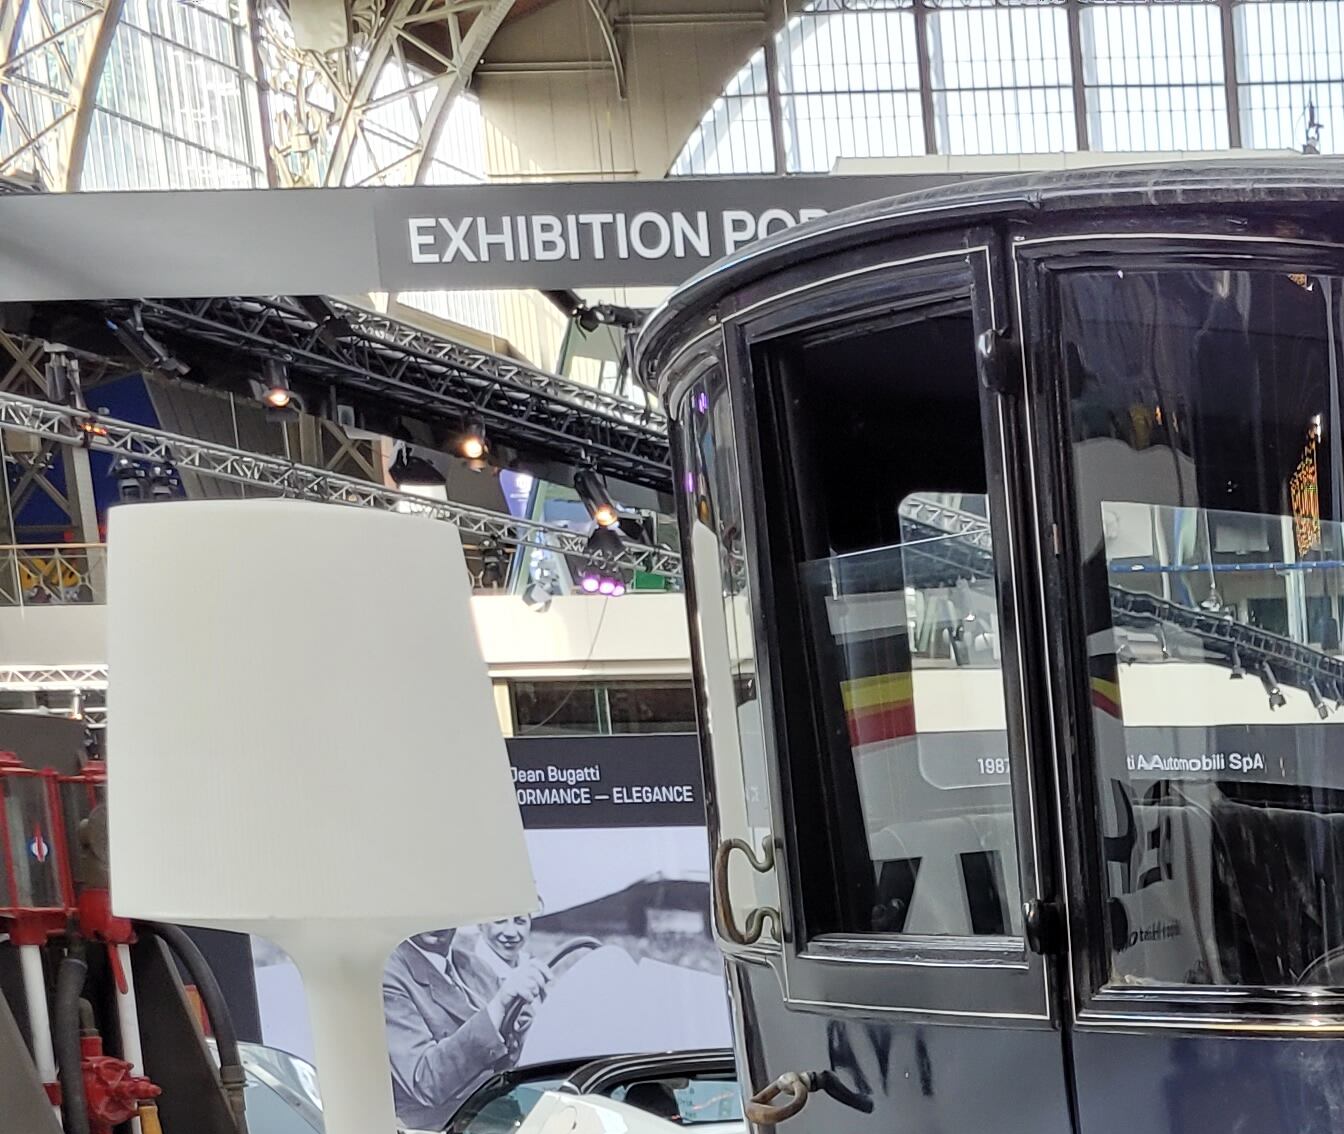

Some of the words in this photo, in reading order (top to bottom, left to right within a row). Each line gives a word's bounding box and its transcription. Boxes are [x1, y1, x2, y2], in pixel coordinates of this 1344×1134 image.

[408, 211, 710, 263] EXHIBITION
[1229, 752, 1264, 773] SpA
[511, 766, 545, 783] Jean
[548, 765, 600, 785] Bugatti
[518, 788, 591, 805] ORMANCE
[613, 786, 694, 803] ELEGANCE
